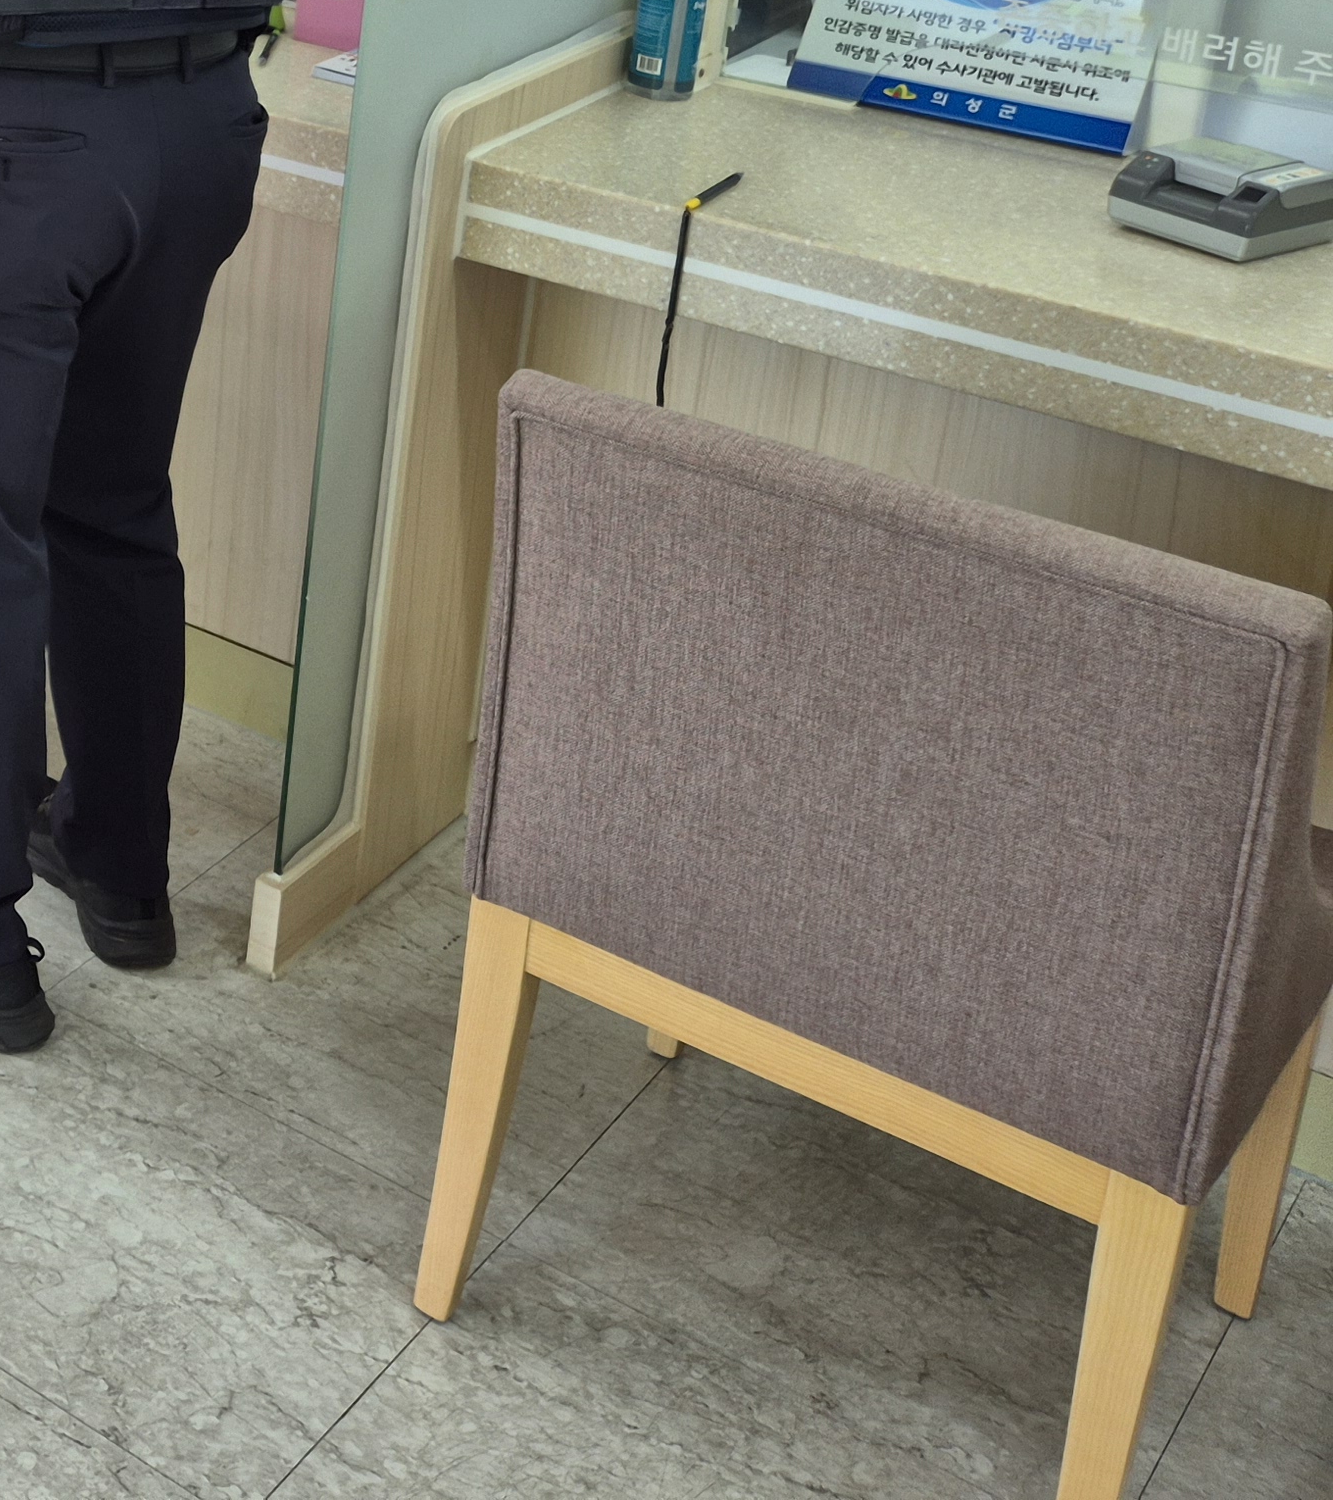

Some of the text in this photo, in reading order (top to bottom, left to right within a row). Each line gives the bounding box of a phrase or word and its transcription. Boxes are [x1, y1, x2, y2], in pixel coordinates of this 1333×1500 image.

[824, 16, 882, 40] 인감증명
[885, 27, 930, 49] 발급을
[907, 8, 953, 29] 사망한
[956, 17, 987, 33] 경우
[834, 42, 1100, 102] 해당할 수 있어 수사기관에 고발됩니다.
[1161, 26, 1282, 79] 배려해
